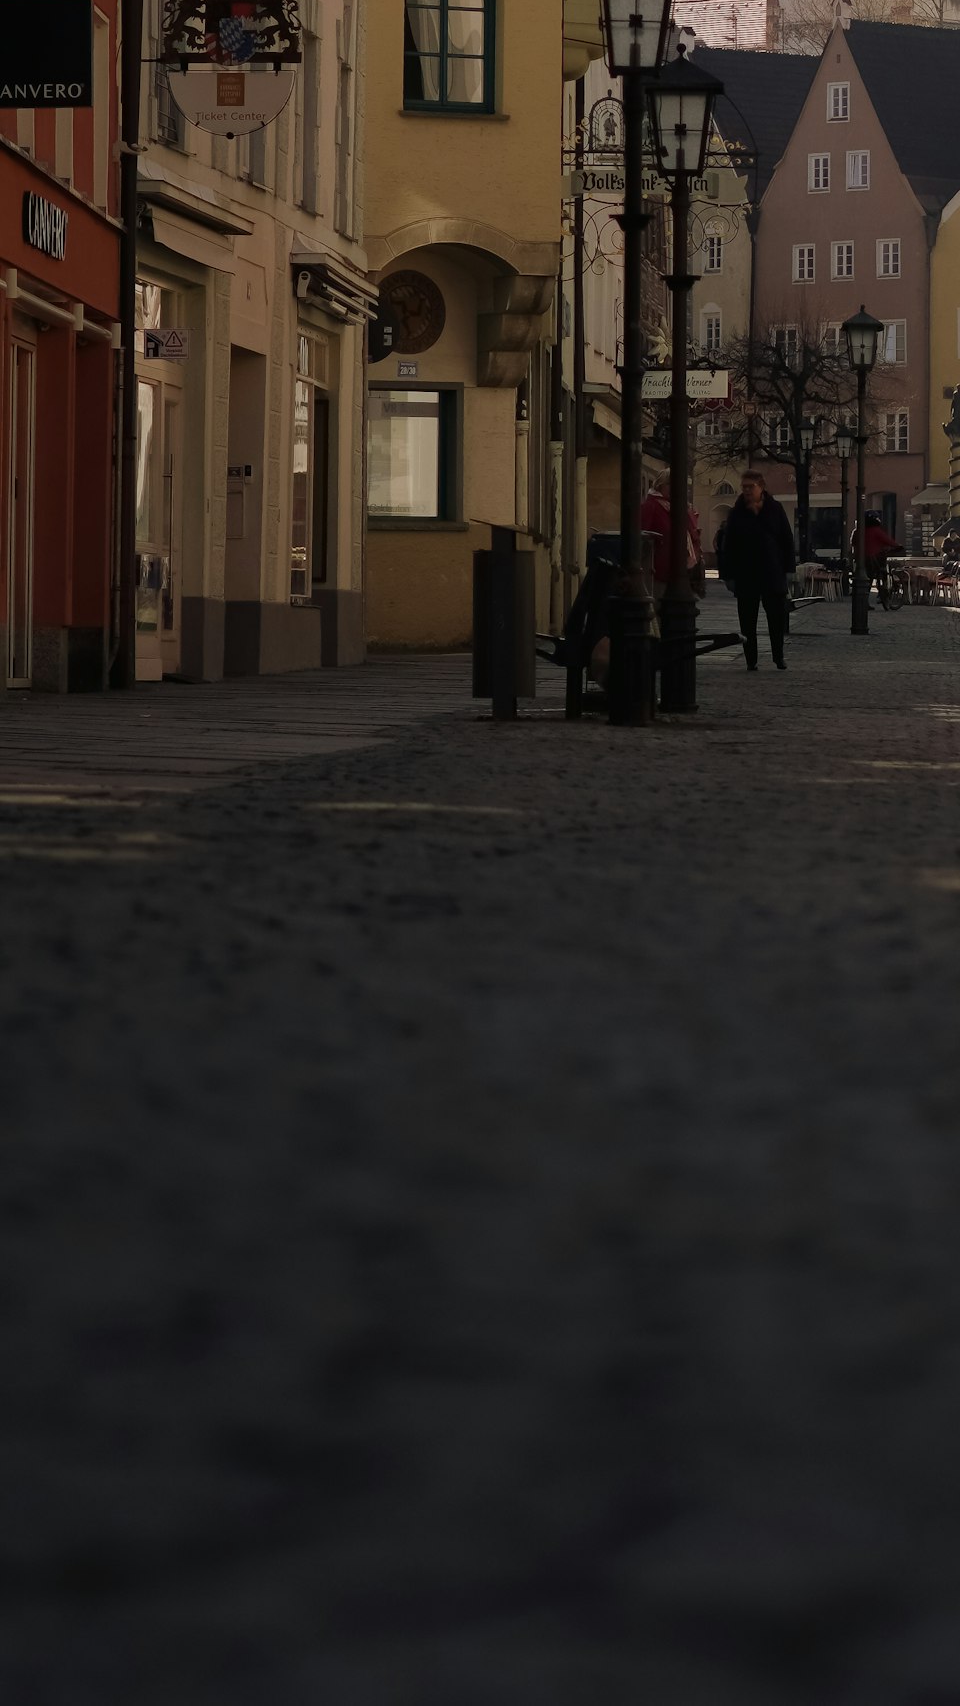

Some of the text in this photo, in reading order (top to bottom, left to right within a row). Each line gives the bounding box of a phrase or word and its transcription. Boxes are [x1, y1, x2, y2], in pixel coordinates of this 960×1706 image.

[196, 112, 266, 121] Ticket Center
[28, 190, 68, 262] CANVERO
